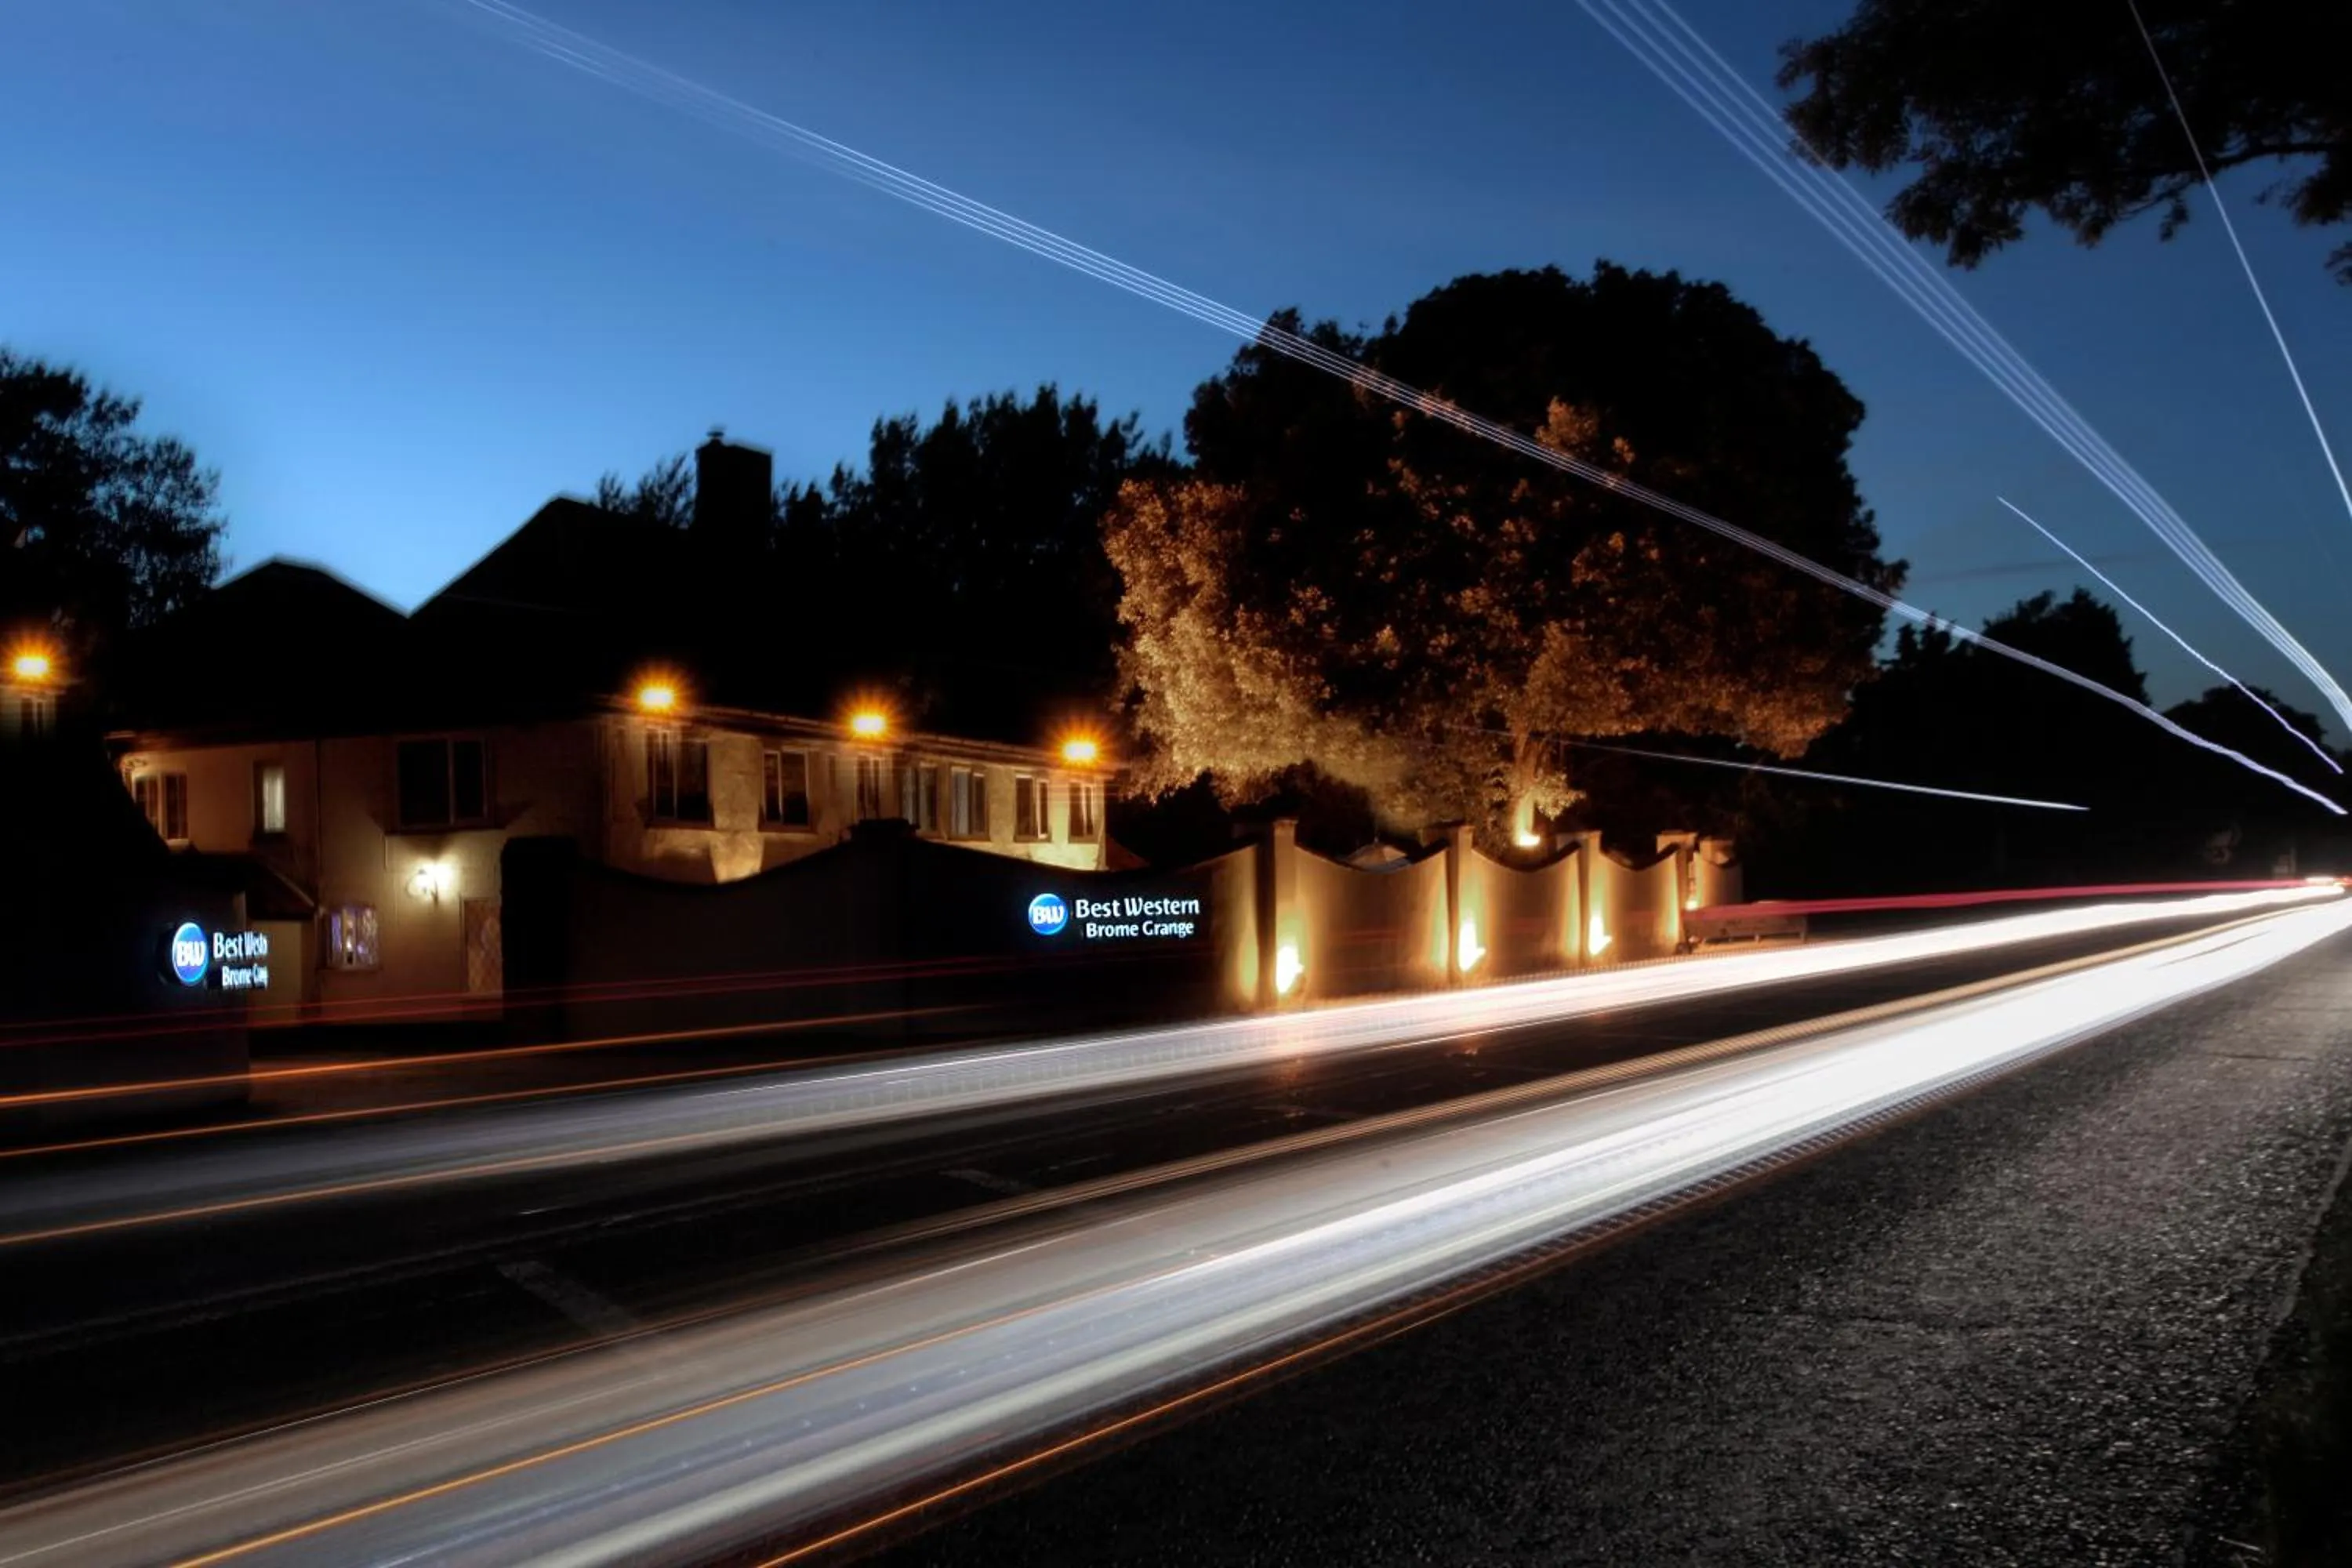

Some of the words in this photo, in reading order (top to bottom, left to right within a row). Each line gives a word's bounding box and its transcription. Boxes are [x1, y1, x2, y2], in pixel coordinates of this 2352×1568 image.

[1032, 906, 1064, 924] BW
[1075, 898, 1120, 919] Best
[1124, 897, 1200, 917] Western
[1085, 922, 1138, 938] Brome
[1142, 920, 1195, 938] Grange
[176, 941, 205, 966] BW
[212, 931, 243, 959] Best
